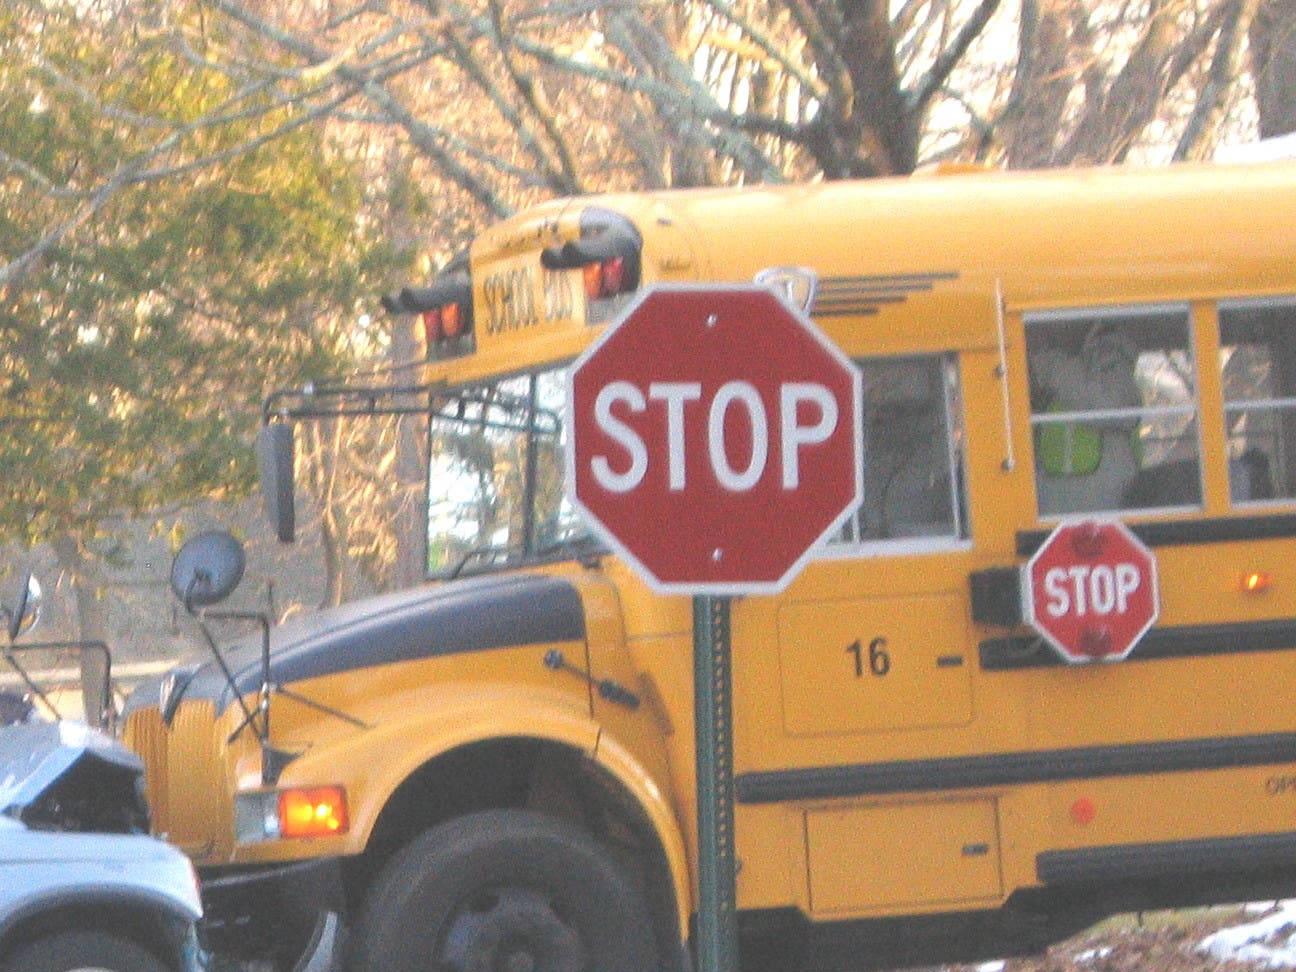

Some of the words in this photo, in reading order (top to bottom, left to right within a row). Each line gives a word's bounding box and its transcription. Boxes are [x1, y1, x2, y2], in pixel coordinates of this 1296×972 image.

[484, 266, 538, 334] SCHOOL
[591, 380, 839, 492] STOP
[1045, 563, 1141, 617] STOP
[846, 637, 891, 677] 16
